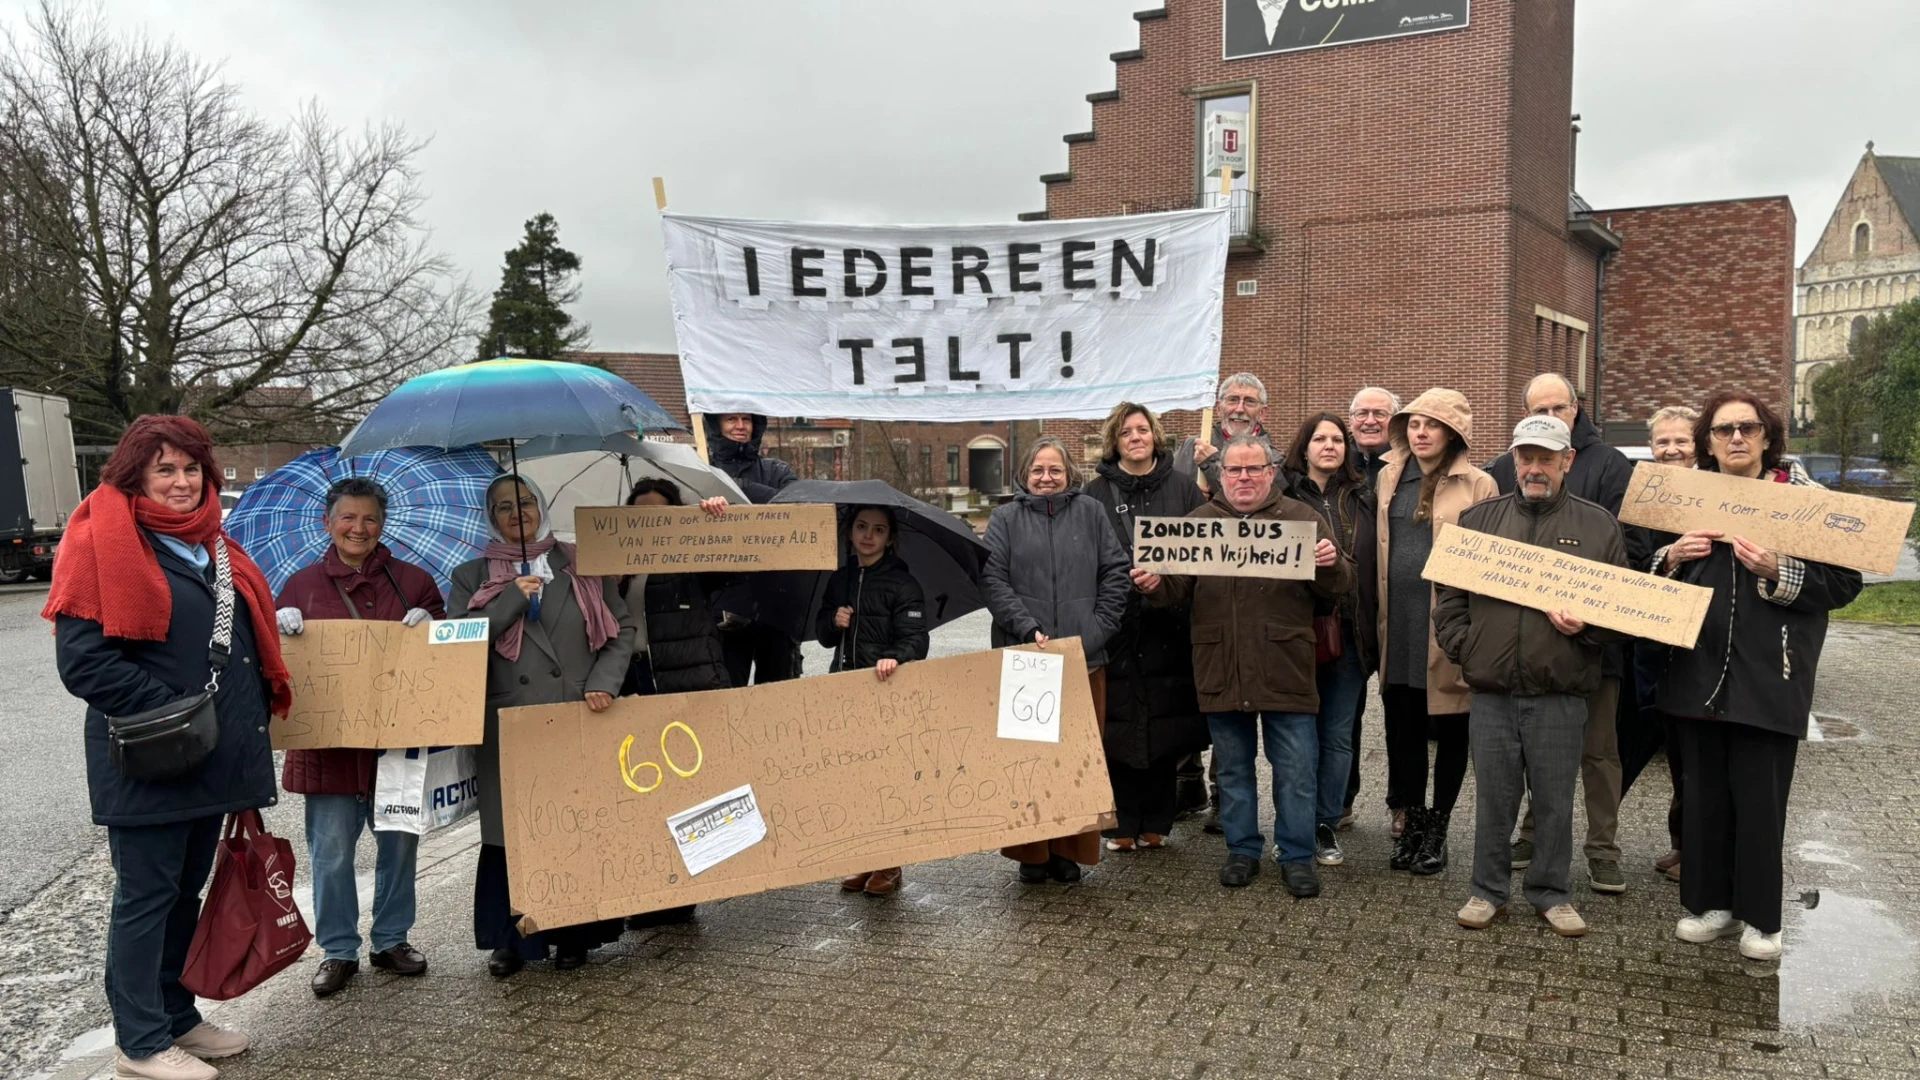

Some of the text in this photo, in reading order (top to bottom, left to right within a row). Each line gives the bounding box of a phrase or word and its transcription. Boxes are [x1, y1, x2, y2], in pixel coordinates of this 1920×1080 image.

[743, 238, 1157, 298] IEDEREEN
[593, 511, 790, 536] WIJ WILLEN OOK GEBRUIK MAKEN
[1140, 521, 1224, 539] ZONDER
[619, 536, 643, 548] VAN
[652, 536, 673, 547] HET
[680, 535, 733, 546] OPENBAAR
[742, 535, 784, 545] VERVOER
[1138, 546, 1213, 563] ZONDER
[1461, 534, 1482, 552] WIJ
[627, 553, 658, 566] LAAT
[661, 554, 689, 564] ONZE
[1446, 546, 1602, 592] GEBRUIK MAKEN VAN LIJN 60
[1481, 571, 1672, 624] HANDEN AF VAN ONZE STOPPLAATS
[320, 622, 389, 666] LIJN
[289, 668, 435, 698] AAT ONS
[282, 698, 400, 739] STAAN!
[1012, 685, 1056, 725] 60
[619, 721, 702, 792] 60
[384, 804, 420, 815] ACTION
[433, 776, 479, 811] ACTIO
